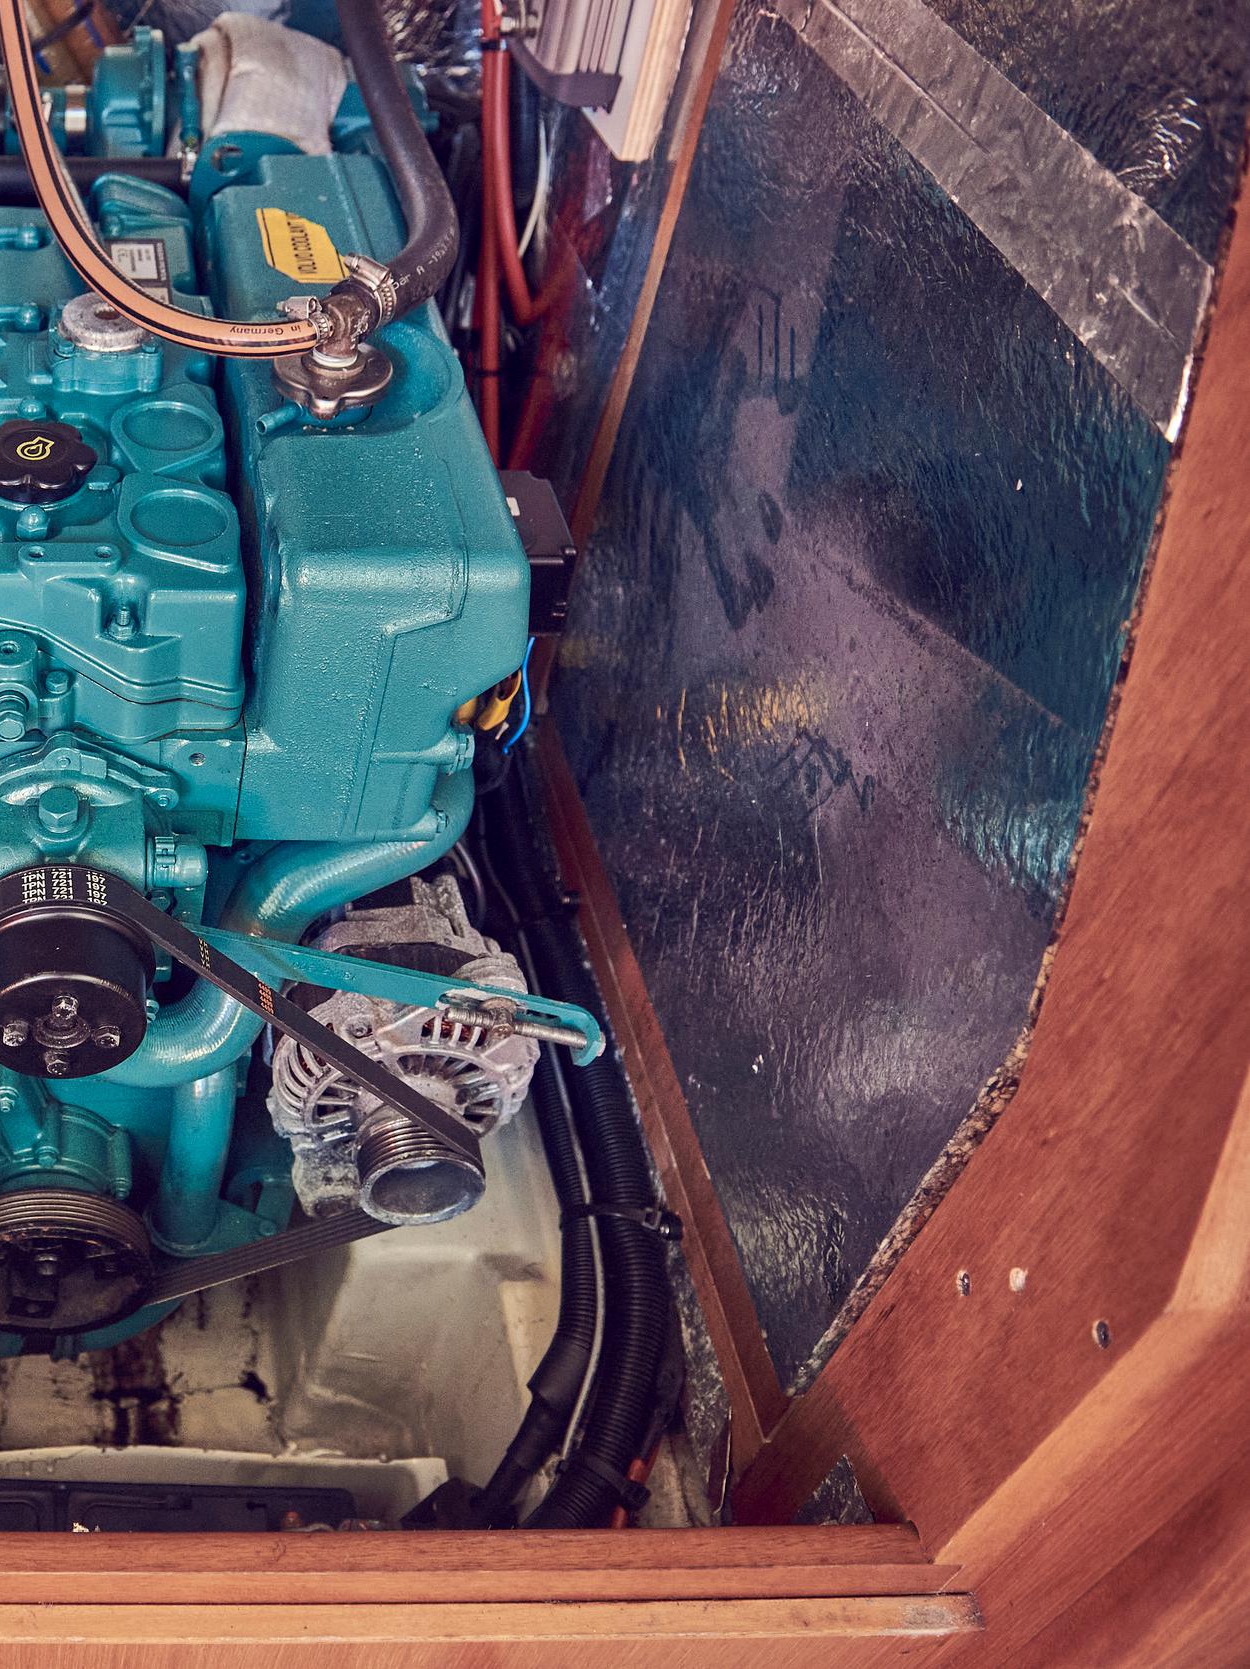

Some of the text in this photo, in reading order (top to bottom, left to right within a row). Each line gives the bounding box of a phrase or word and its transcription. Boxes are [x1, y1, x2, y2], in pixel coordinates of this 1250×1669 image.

[229, 325, 284, 335] Germany
[290, 325, 302, 333] in
[21, 871, 106, 884] TPN 721 197
[21, 879, 107, 892] TPN 721 197
[21, 887, 107, 900] TPN 721 197
